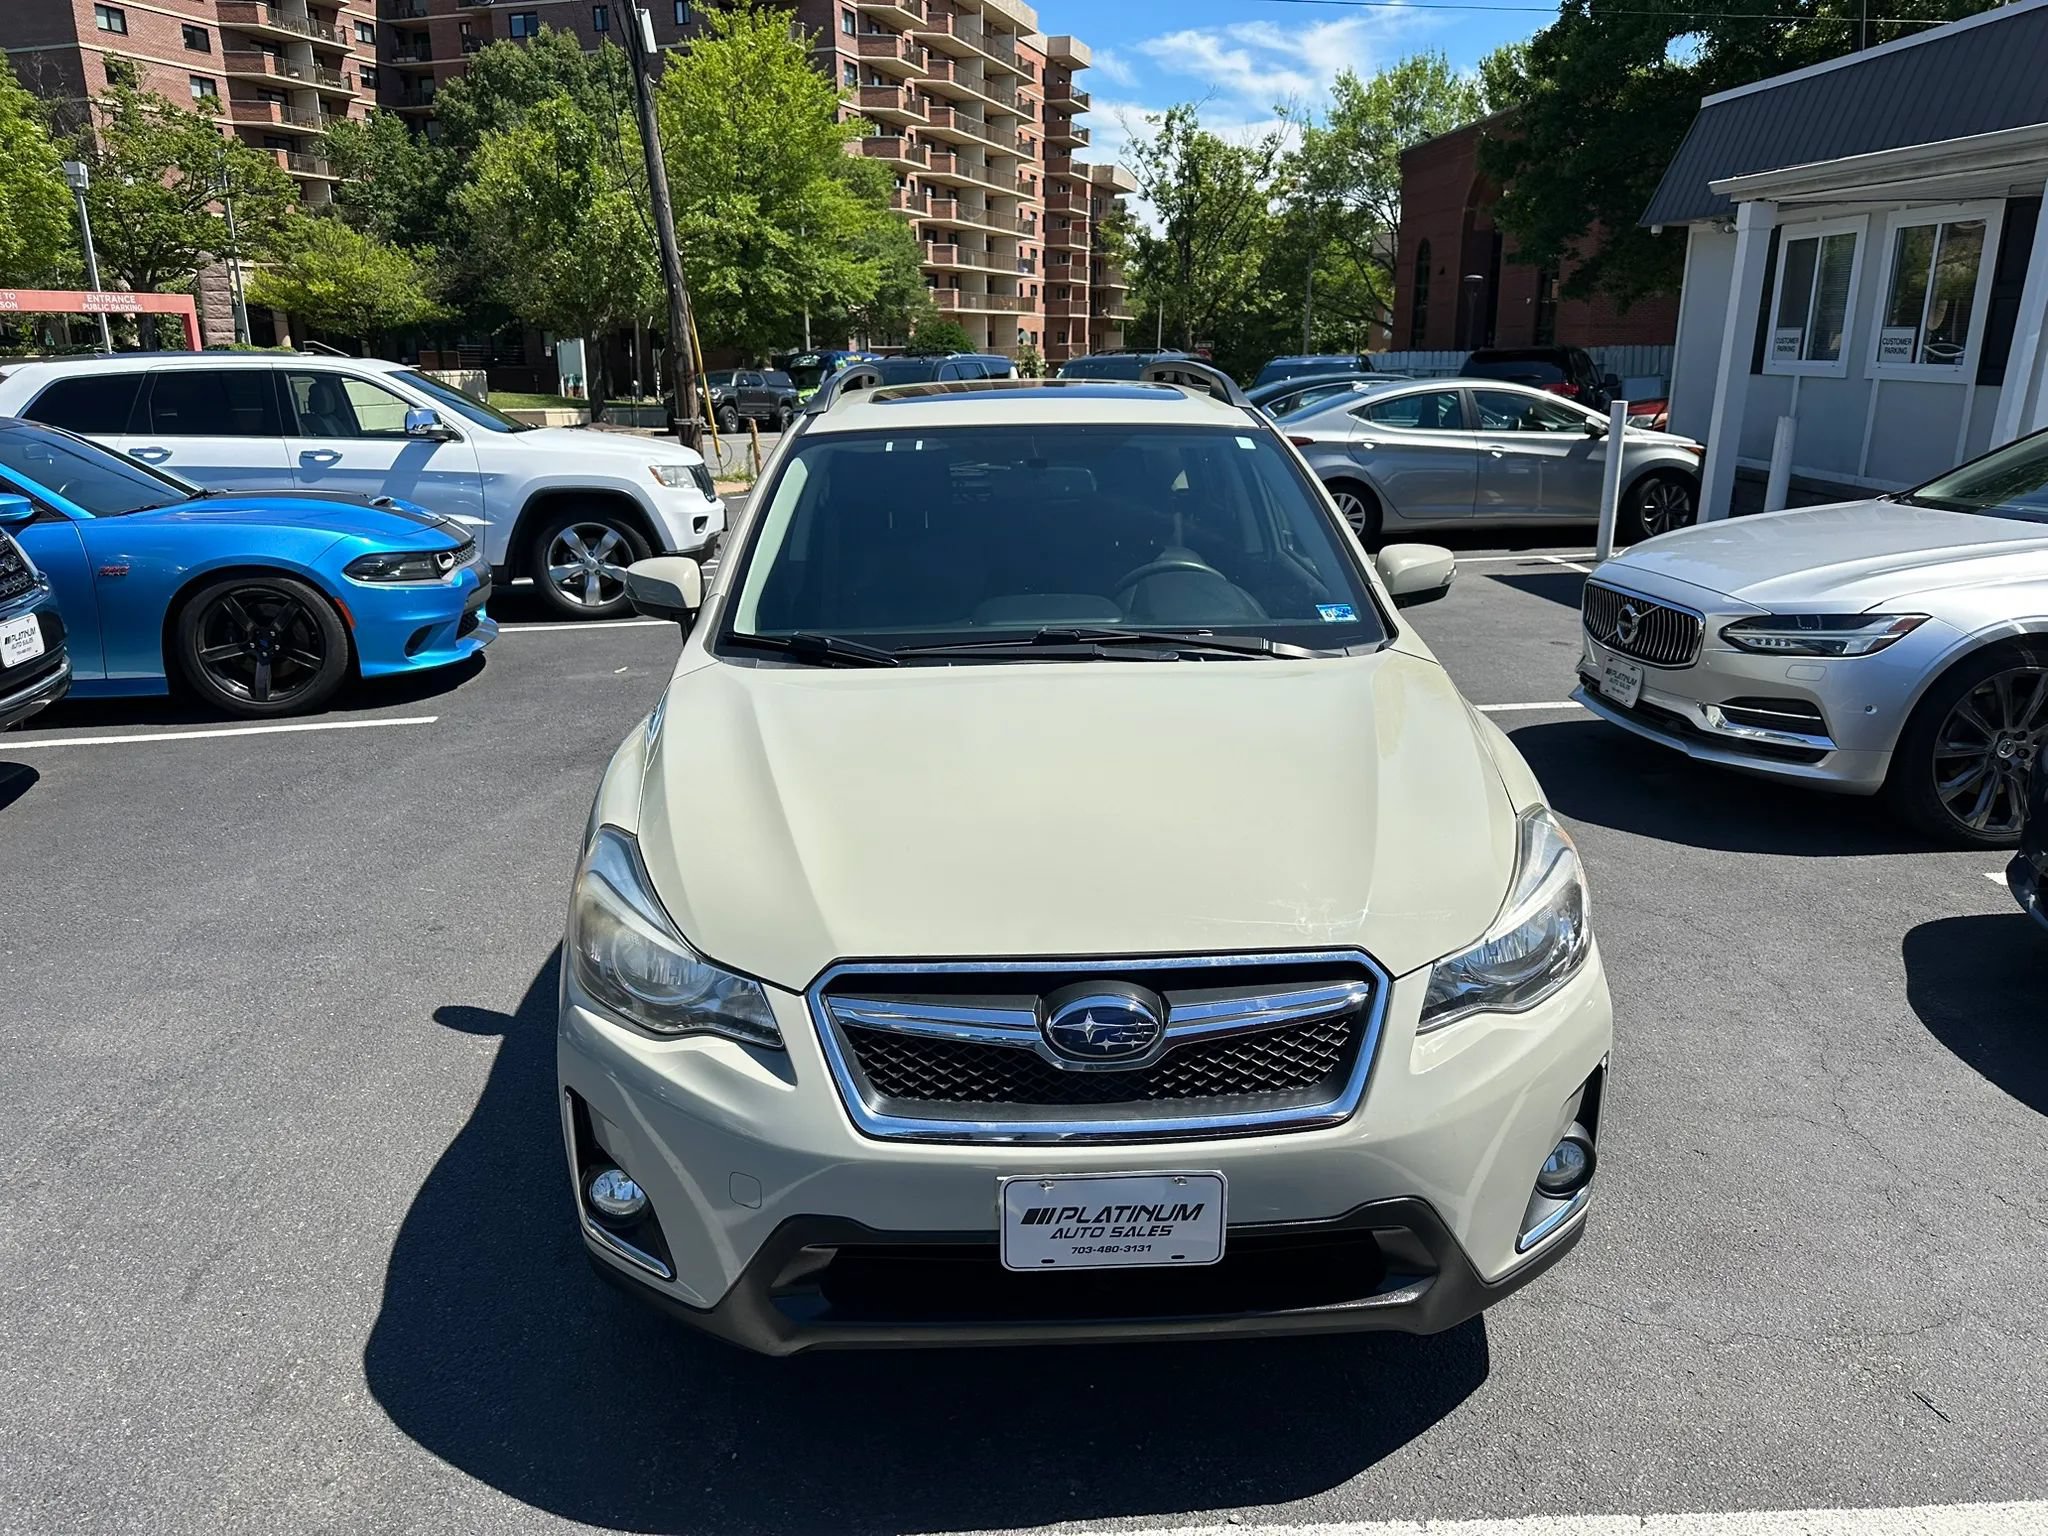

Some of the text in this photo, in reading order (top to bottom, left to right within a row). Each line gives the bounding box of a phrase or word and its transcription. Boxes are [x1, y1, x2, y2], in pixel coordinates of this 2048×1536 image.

[3, 292, 16, 300] TO
[86, 294, 136, 303] ENTRANCE
[82, 303, 144, 312] PUBLIC PARKING
[1881, 337, 1913, 345] CUSTOMER
[1884, 347, 1908, 355] PARKING
[11, 627, 36, 642] PLATINUM
[1611, 670, 1637, 686] PLATINUM
[1055, 1203, 1205, 1224] PLATINUM
[1049, 1225, 1174, 1239] AUTO SALES
[1071, 1244, 1152, 1255] 703-480-3131
